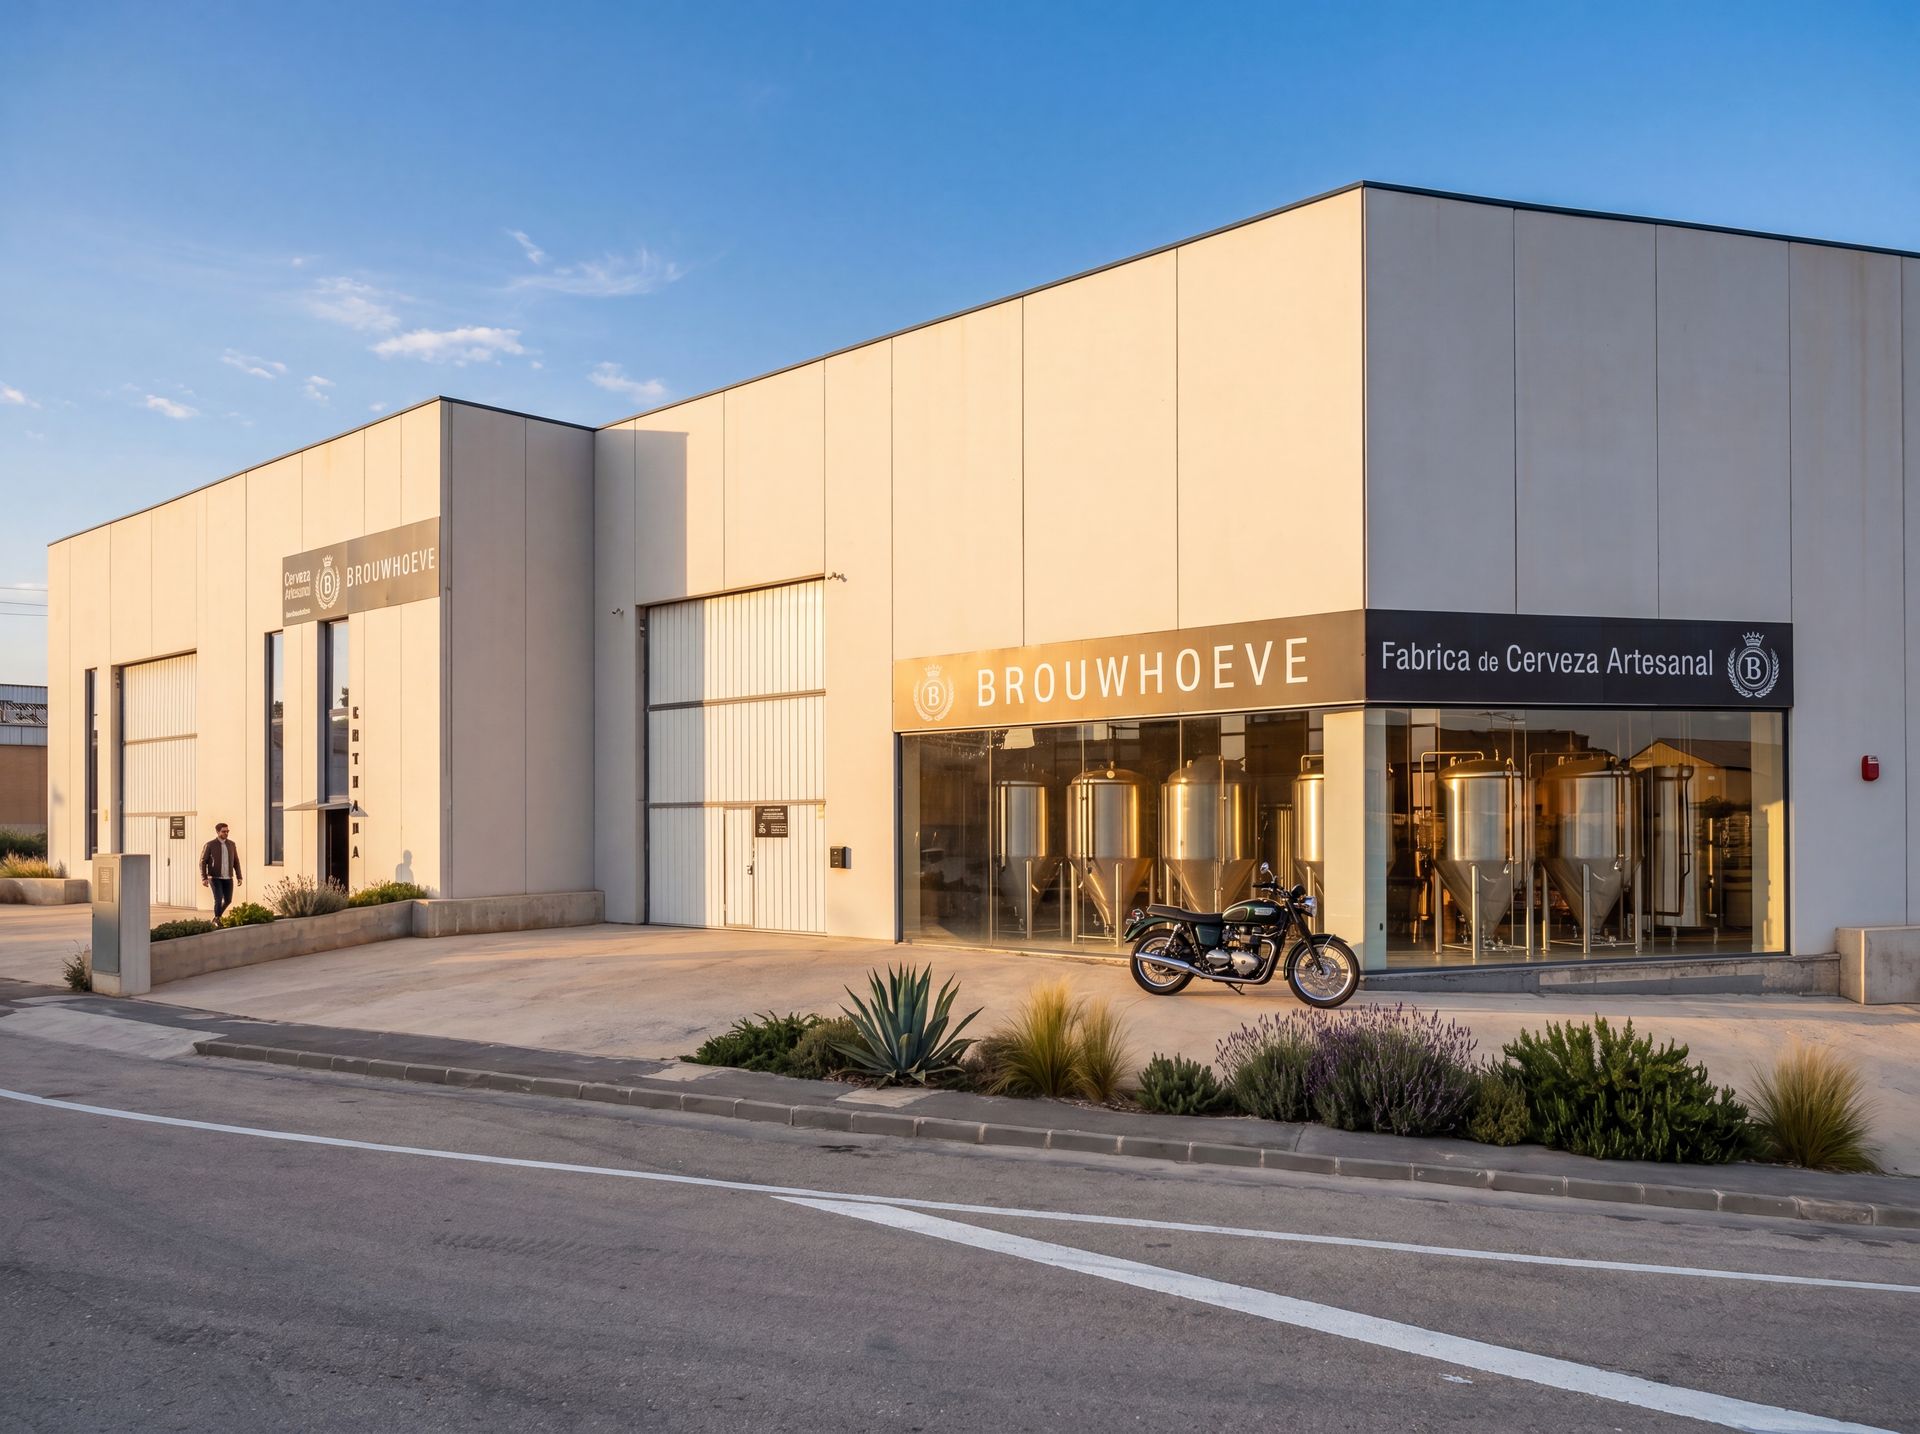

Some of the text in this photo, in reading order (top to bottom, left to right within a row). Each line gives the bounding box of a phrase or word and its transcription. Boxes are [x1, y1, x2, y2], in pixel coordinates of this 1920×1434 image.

[347, 548, 435, 587] BROUWHOEVE
[977, 637, 1309, 707] BROUWHOEVE
[1382, 641, 1713, 676] Fabrica de Cerveza Artesanal
[1744, 656, 1762, 680] B
[926, 685, 940, 707] B
